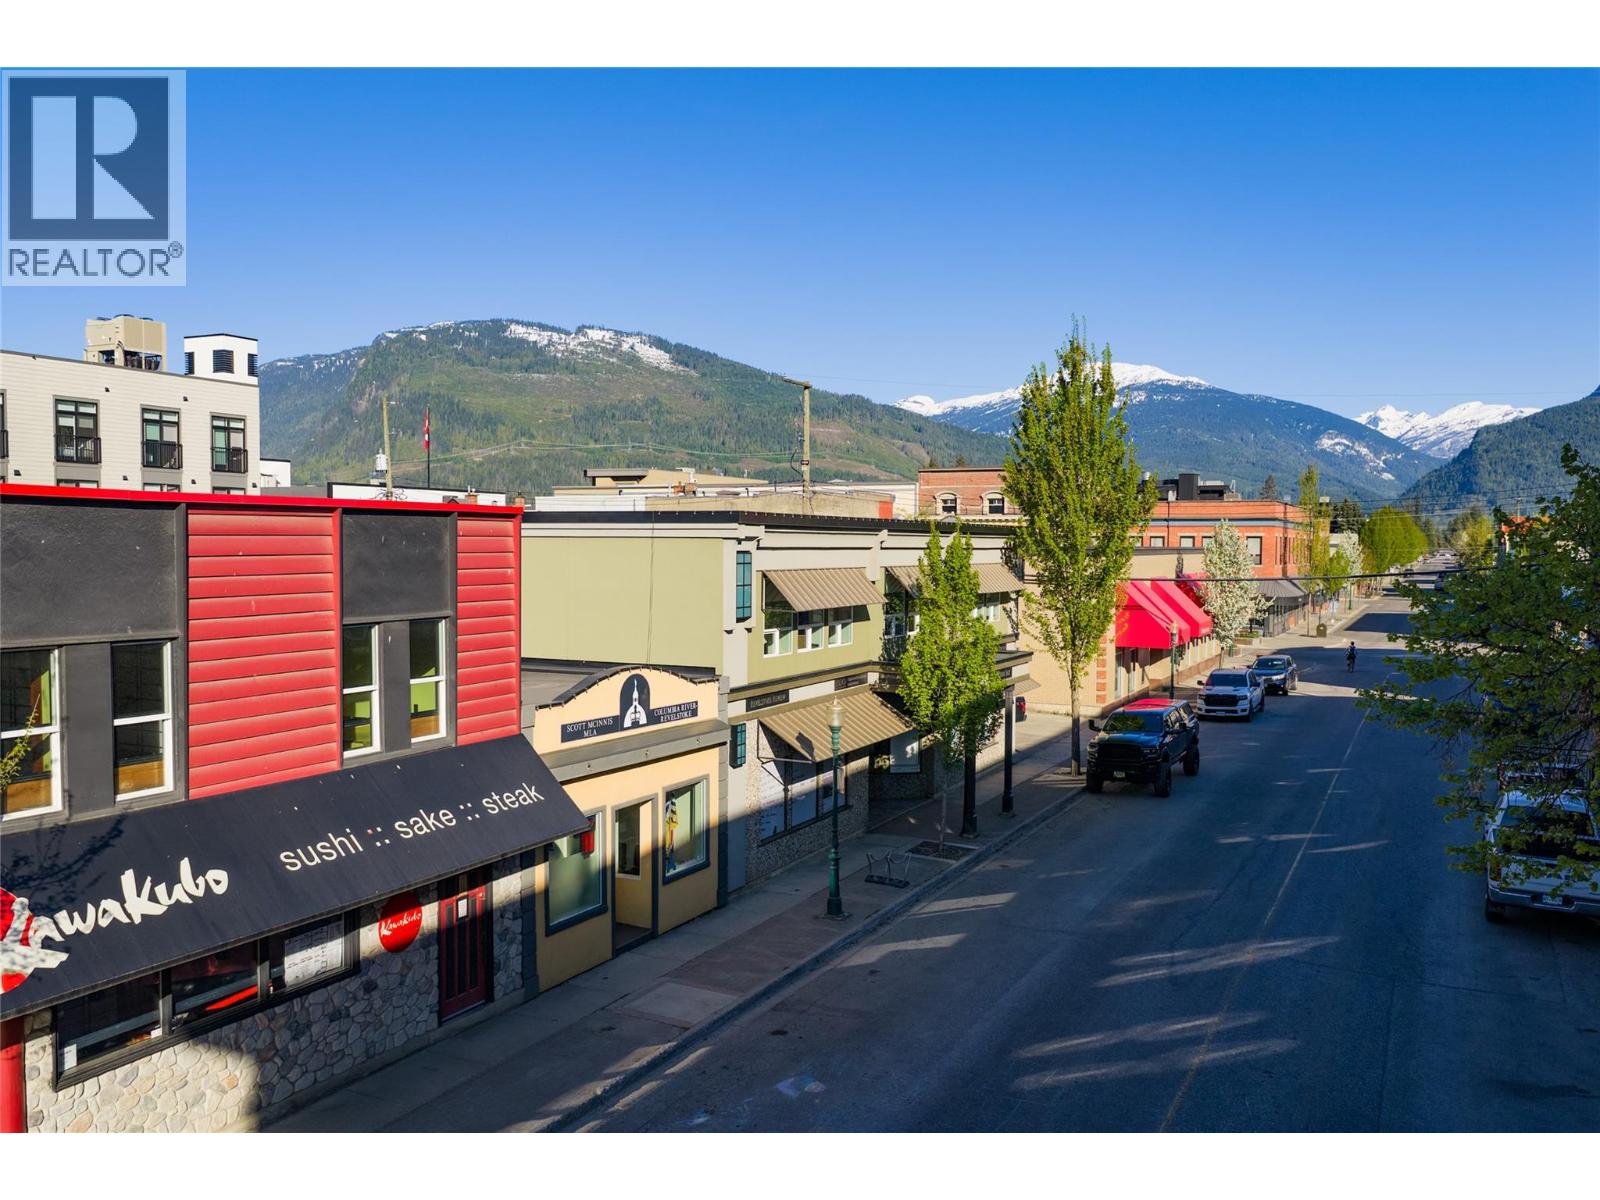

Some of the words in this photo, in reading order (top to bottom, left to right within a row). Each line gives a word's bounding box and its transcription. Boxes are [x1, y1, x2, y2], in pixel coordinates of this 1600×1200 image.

[654, 704, 681, 717] COLUMBIA
[660, 710, 693, 722] REVELSTOKE
[566, 723, 586, 733] SCOTT
[587, 717, 614, 730] MCINNIS
[583, 729, 597, 738] MLA
[279, 827, 364, 872] sushi
[394, 809, 457, 839] sake
[482, 782, 545, 815] steak
